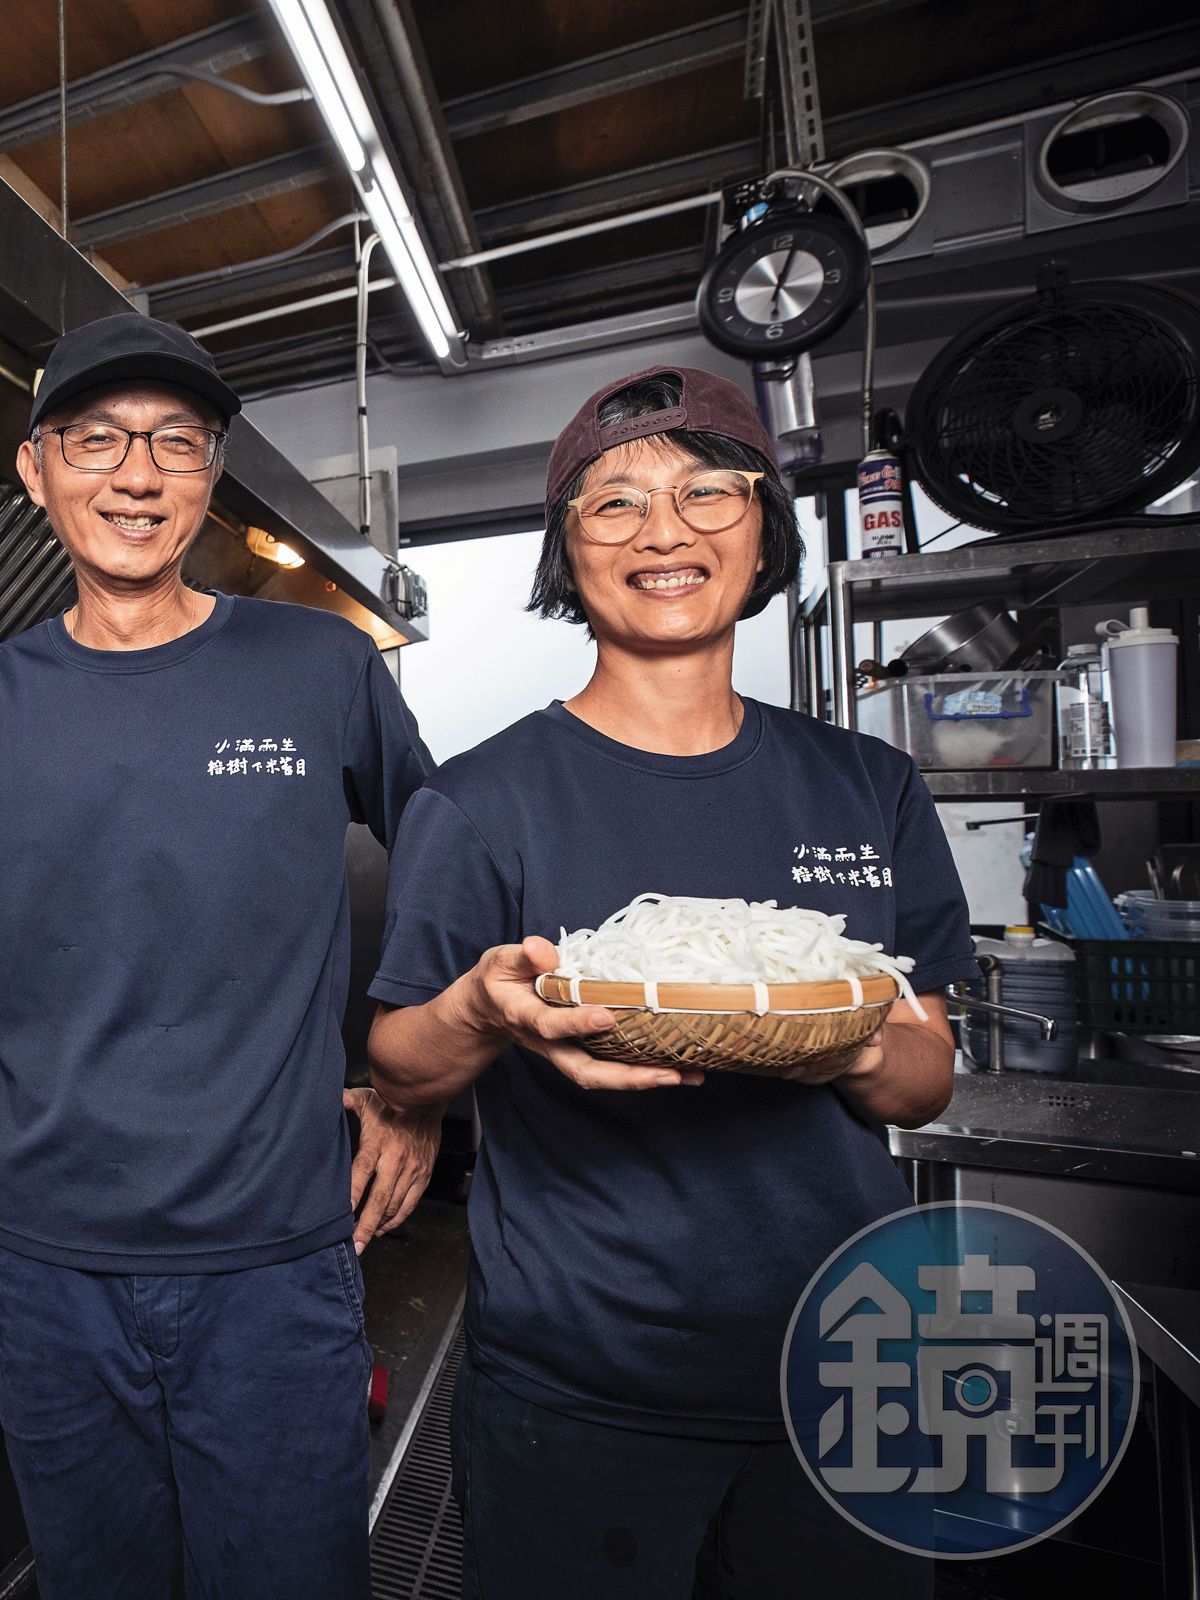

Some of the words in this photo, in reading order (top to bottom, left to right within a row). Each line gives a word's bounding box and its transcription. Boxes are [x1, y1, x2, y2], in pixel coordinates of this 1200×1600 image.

[774, 235, 794, 250] 12
[824, 269, 842, 285] 3
[718, 288, 734, 304] 9
[766, 323, 785, 339] 6
[863, 511, 902, 532] GAS
